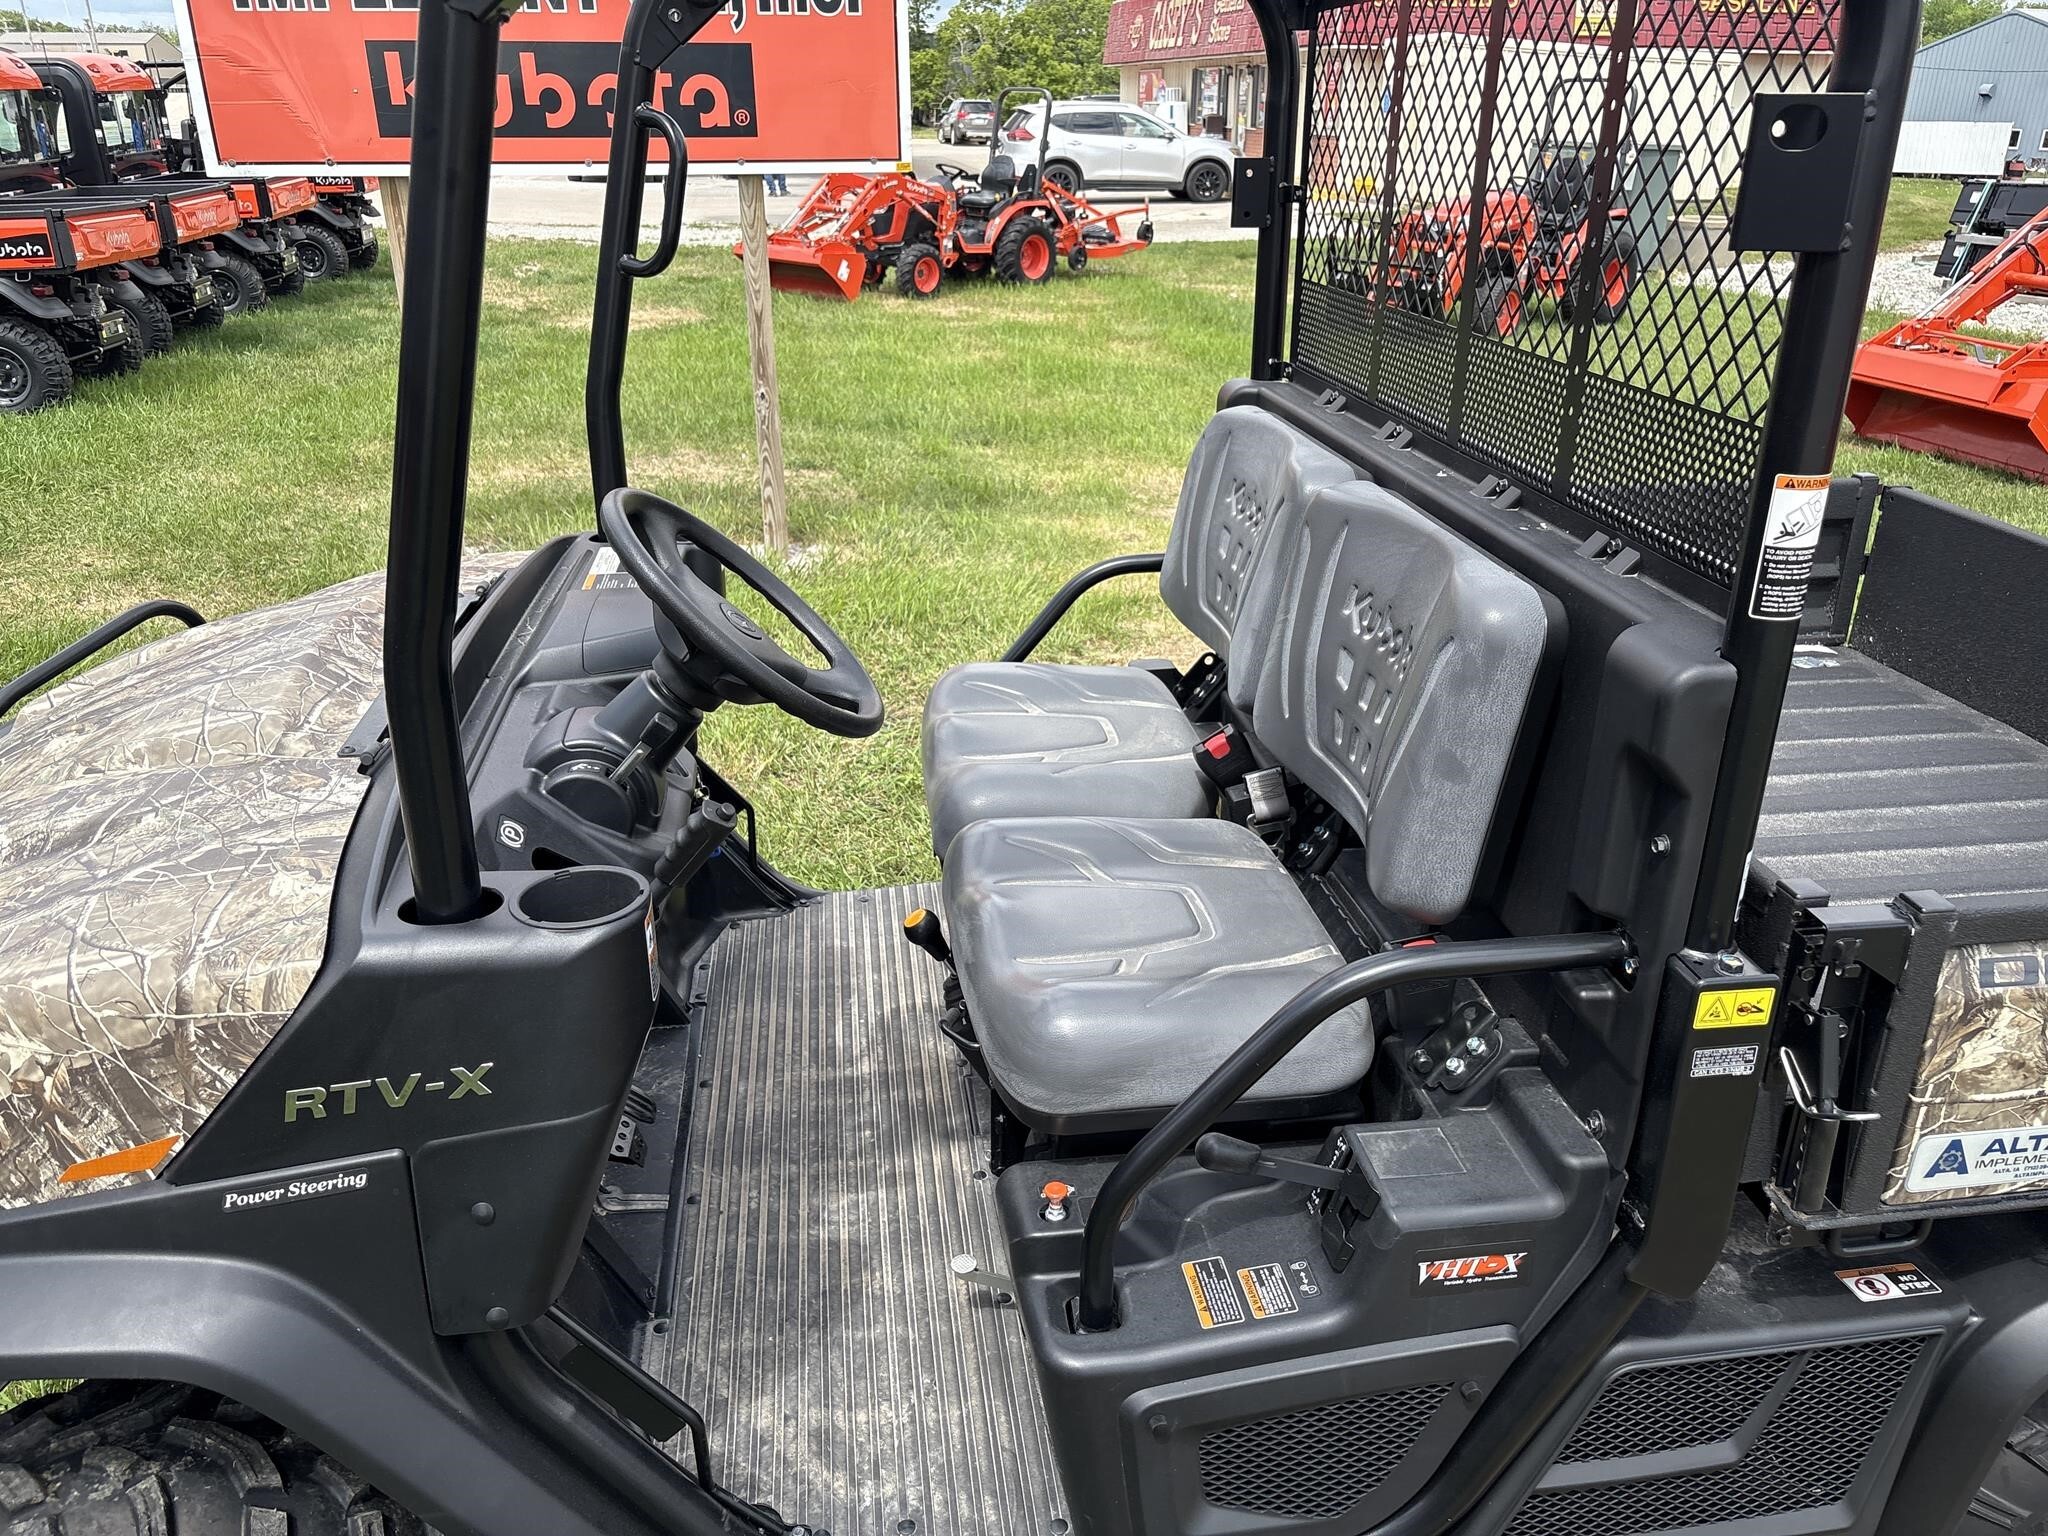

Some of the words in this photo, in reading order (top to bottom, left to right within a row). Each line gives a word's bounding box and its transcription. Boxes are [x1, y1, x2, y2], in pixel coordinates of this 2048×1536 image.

[0, 242, 45, 257] ubota
[284, 1062, 494, 1123] RTV-X
[1980, 1134, 2048, 1157] ALT
[1974, 1153, 2048, 1169] IMPLEME
[223, 1188, 285, 1209] Power
[288, 1173, 367, 1200] Steering
[1418, 1252, 1528, 1286] VHT-X
[1897, 1274, 1918, 1282] NO
[1189, 1274, 1205, 1308] WARNING
[1242, 1274, 1259, 1309] WARNING
[1898, 1281, 1931, 1291] STEP
